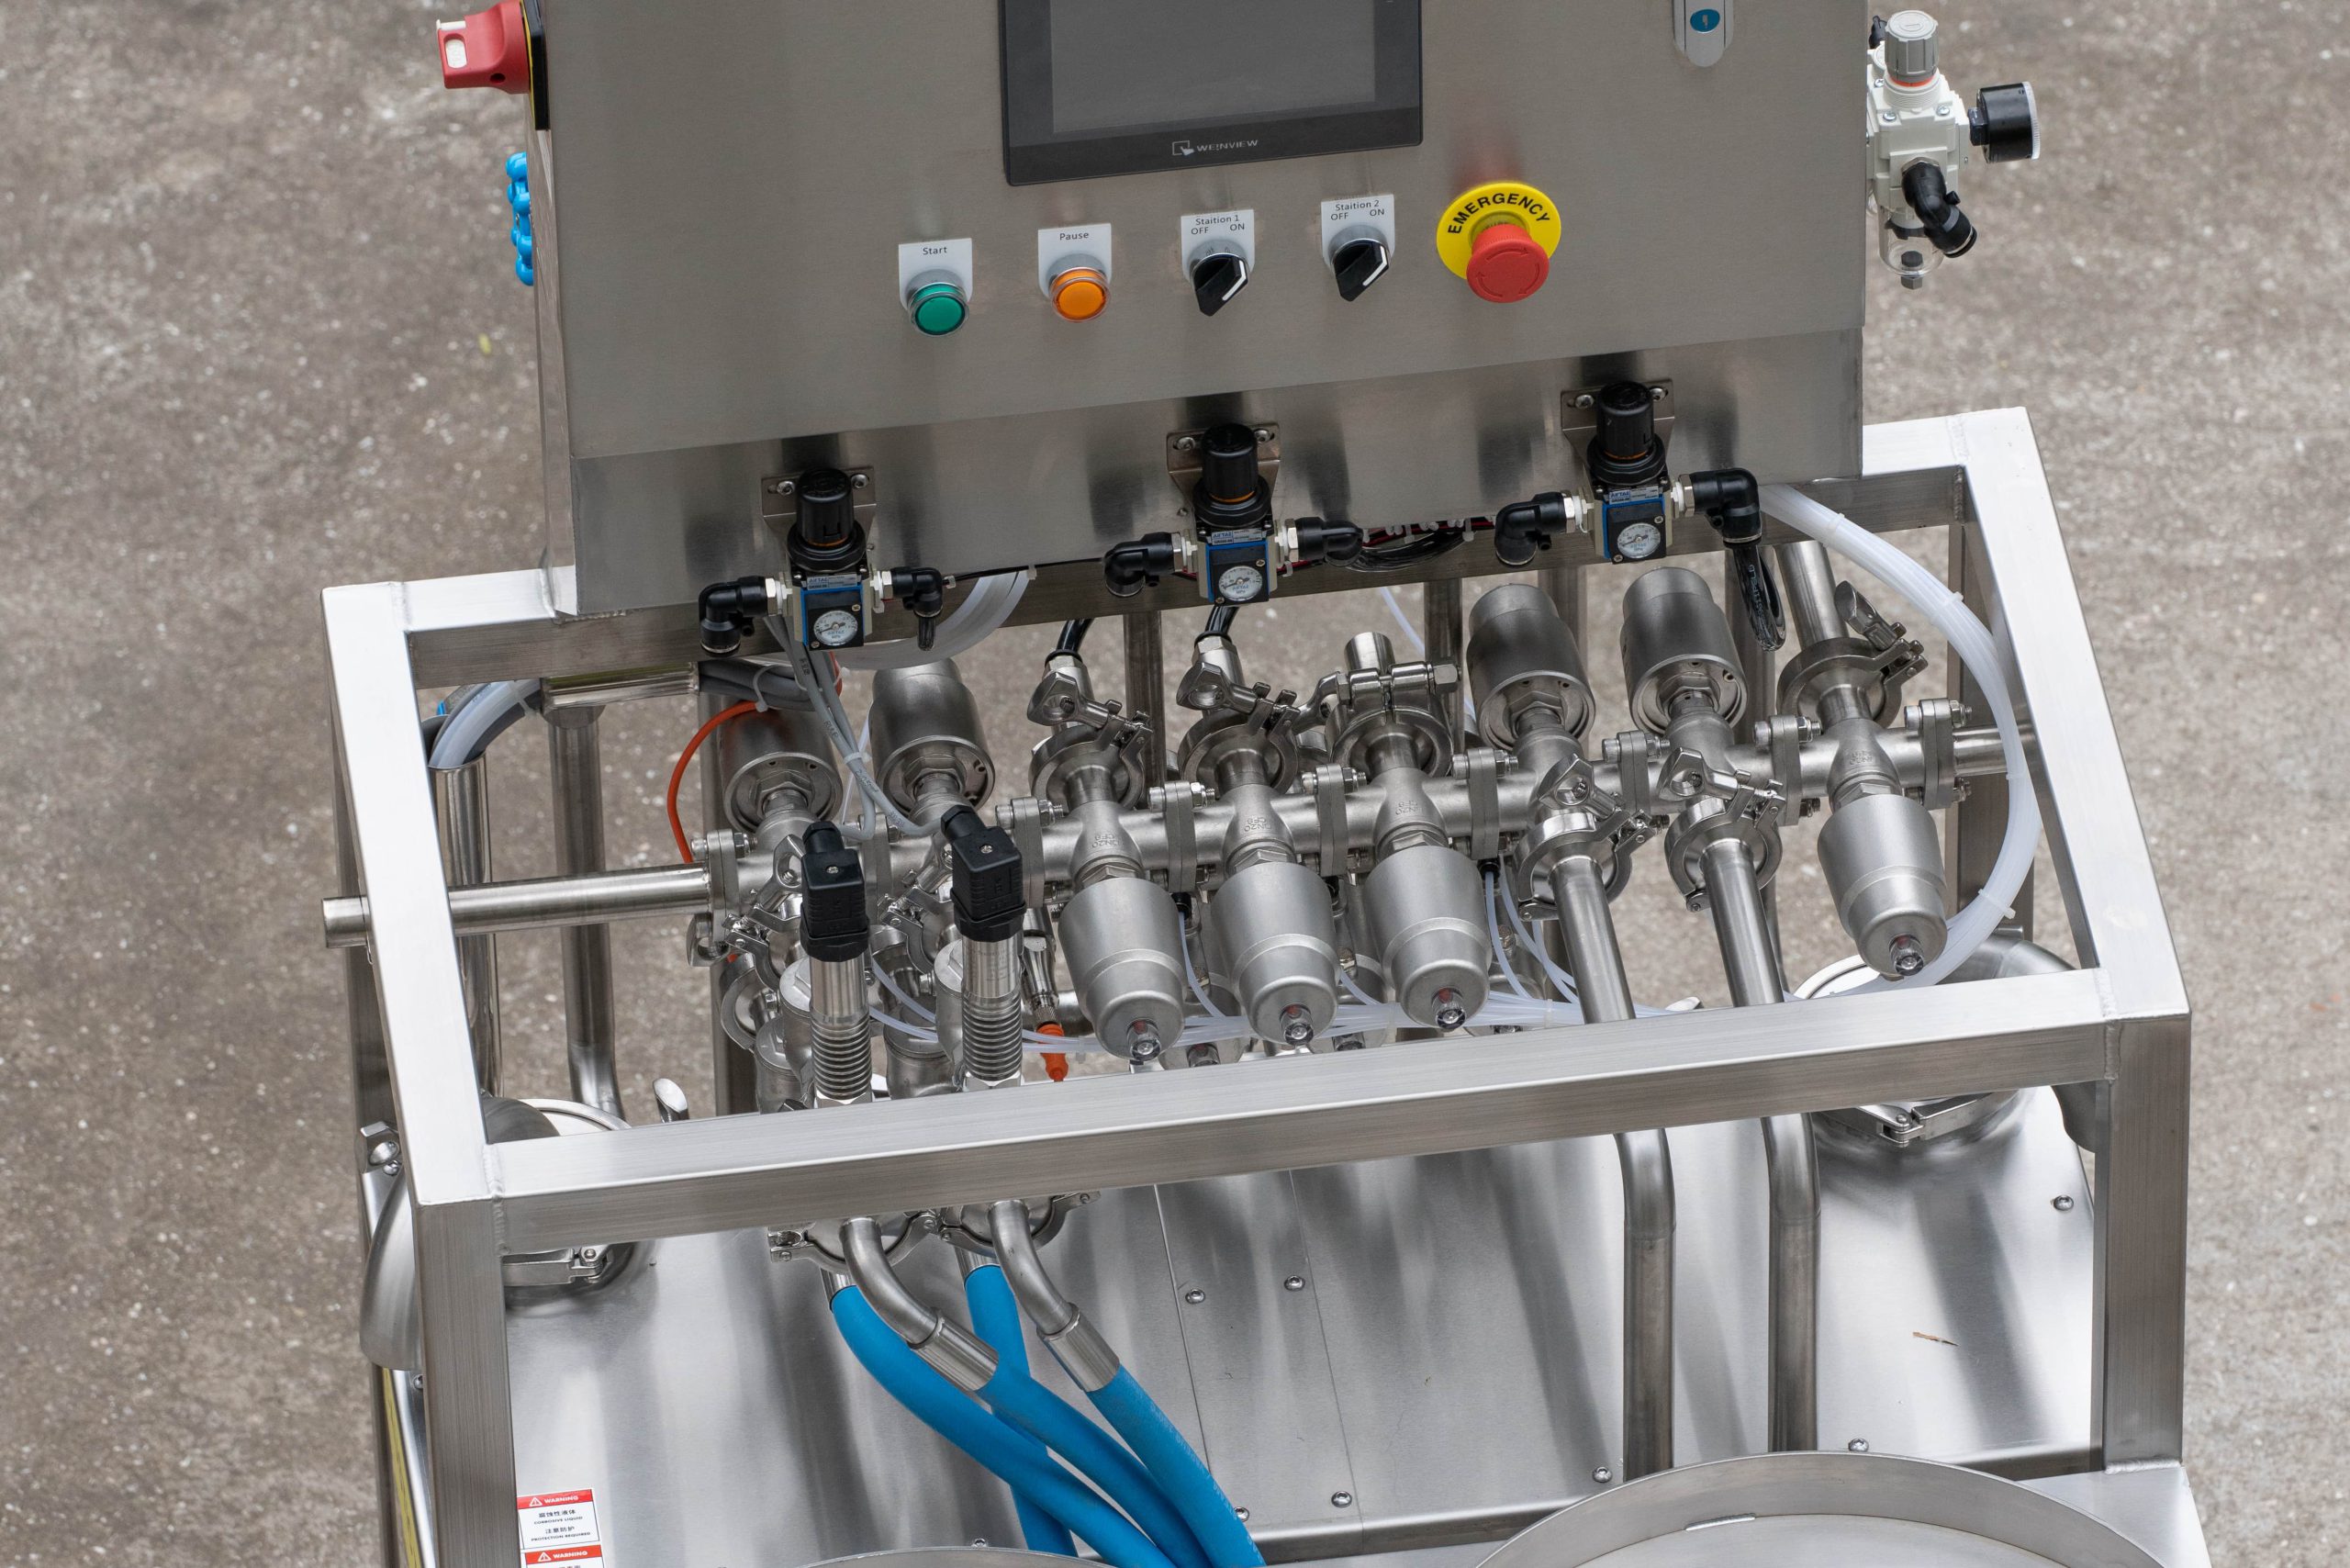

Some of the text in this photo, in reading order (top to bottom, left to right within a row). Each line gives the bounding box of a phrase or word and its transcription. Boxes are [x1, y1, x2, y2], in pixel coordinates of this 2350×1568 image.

[1374, 199, 1380, 207] 2
[1234, 214, 1239, 222] 1
[1330, 208, 1385, 221] OFF ON
[1448, 193, 1550, 234] EMERGENCY
[1191, 222, 1245, 235] OFF ON
[1059, 231, 1090, 241] Pause
[923, 246, 948, 255] Start
[544, 1495, 579, 1504] WARNING
[553, 1550, 588, 1559] WARNING
